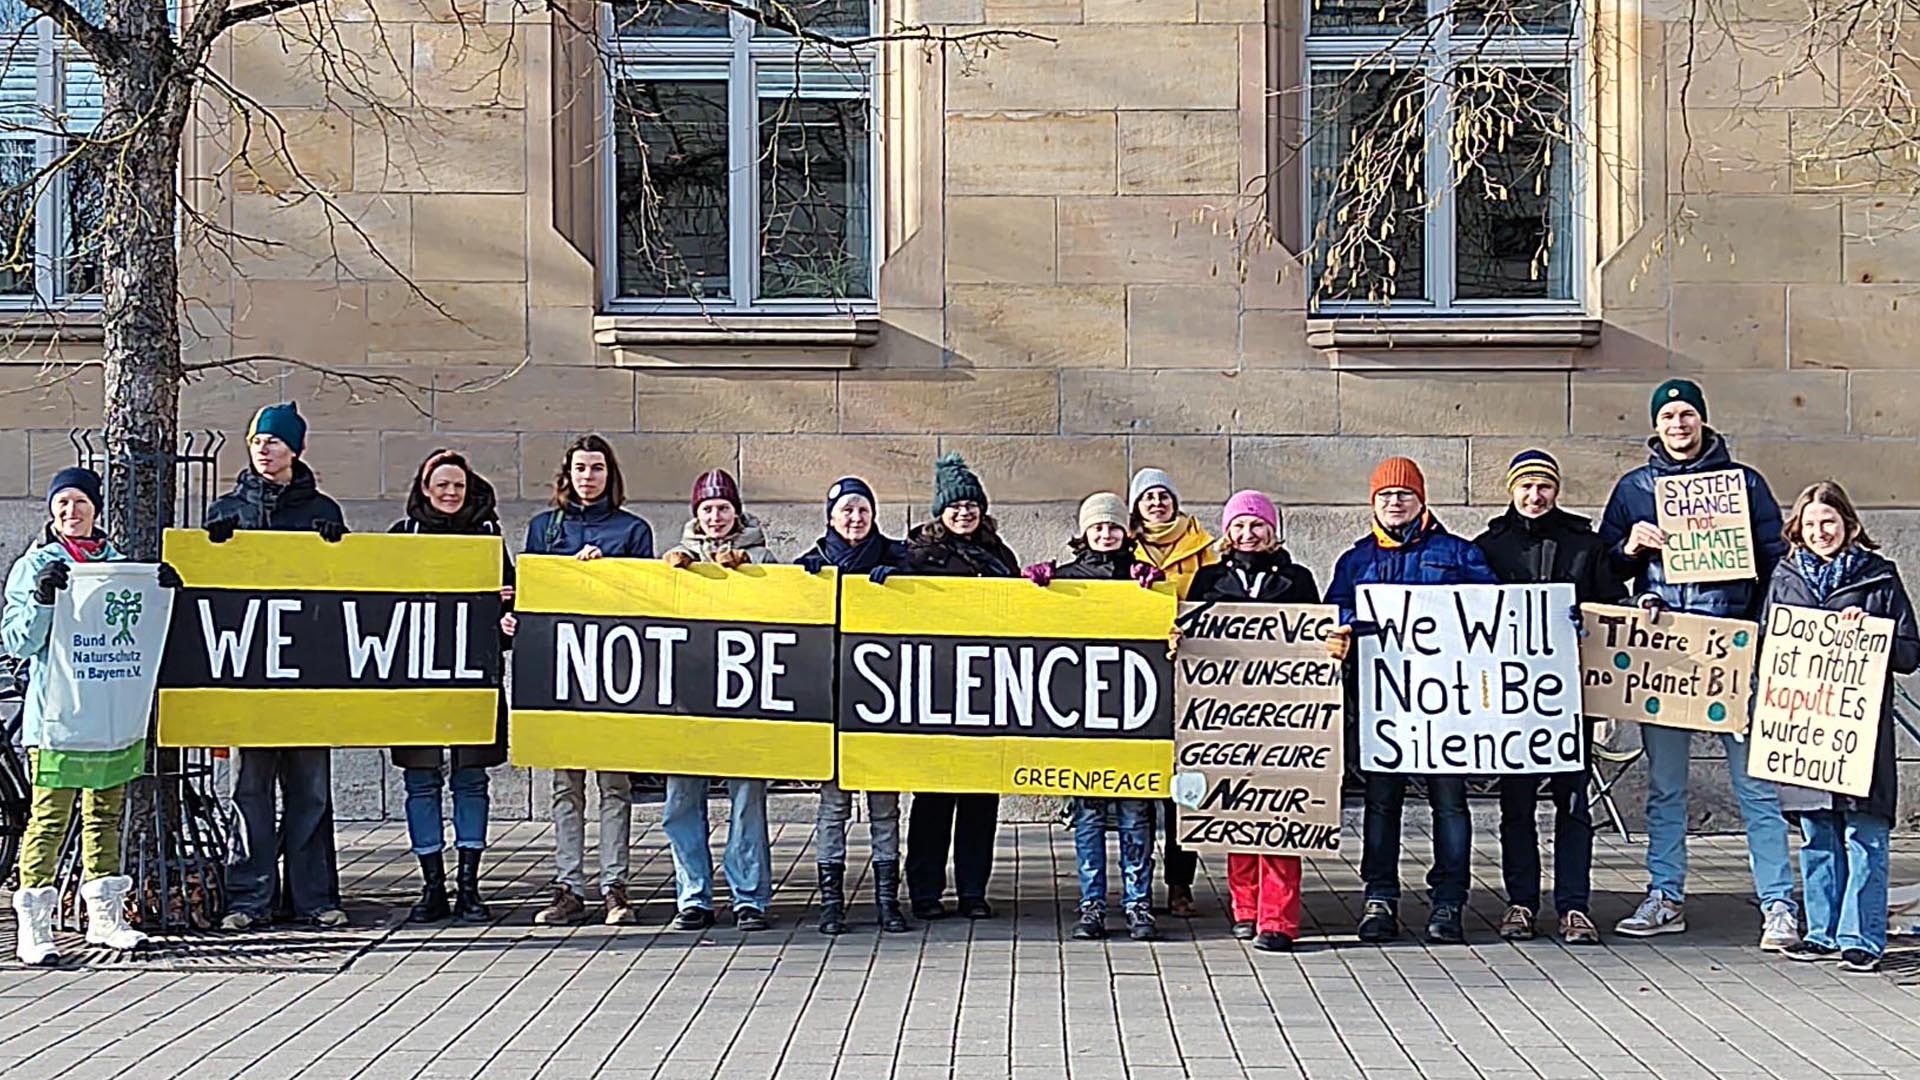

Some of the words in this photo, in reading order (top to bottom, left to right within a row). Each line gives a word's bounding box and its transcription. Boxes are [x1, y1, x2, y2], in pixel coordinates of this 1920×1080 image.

[1664, 473, 1742, 499] SYSTEM
[1664, 493, 1742, 517] CHANGE
[1687, 513, 1717, 531] not
[1667, 527, 1747, 551] CLIMATE
[1670, 548, 1750, 571] CHANGE
[73, 633, 106, 647] Bund
[199, 599, 301, 678] WE
[343, 601, 483, 680] WILL
[1364, 589, 1442, 655] We
[1454, 589, 1554, 656] Will
[1598, 615, 1689, 651] There
[1706, 629, 1728, 659] is
[1771, 607, 1818, 642] Das
[73, 650, 141, 664] Naturschutz
[73, 667, 85, 679] in
[88, 667, 125, 681] Bayern
[556, 623, 688, 705] NOT
[716, 630, 796, 712] BE
[1181, 659, 1239, 685] VON
[1242, 660, 1341, 686] UNSEREN
[1772, 645, 1802, 678] ist
[1807, 648, 1870, 686] nicht
[852, 643, 1157, 730] SILENCED
[1374, 658, 1472, 715] Not
[1500, 661, 1563, 716] Be
[1584, 669, 1613, 686] no
[1624, 661, 1700, 704] planet
[1180, 698, 1342, 730] KLAGERECHT
[1839, 686, 1867, 721] Es
[1373, 713, 1581, 770] Silenced
[1760, 716, 1825, 746] wurde
[1832, 729, 1858, 754] so
[1180, 742, 1263, 766] GEGEN
[1261, 745, 1331, 769] EURE
[1767, 747, 1851, 787] erbaut.
[1013, 767, 1161, 792] GREENPEACE
[1199, 778, 1326, 814] NATUR-
[1180, 815, 1342, 850] ZERSTÖRUNG
